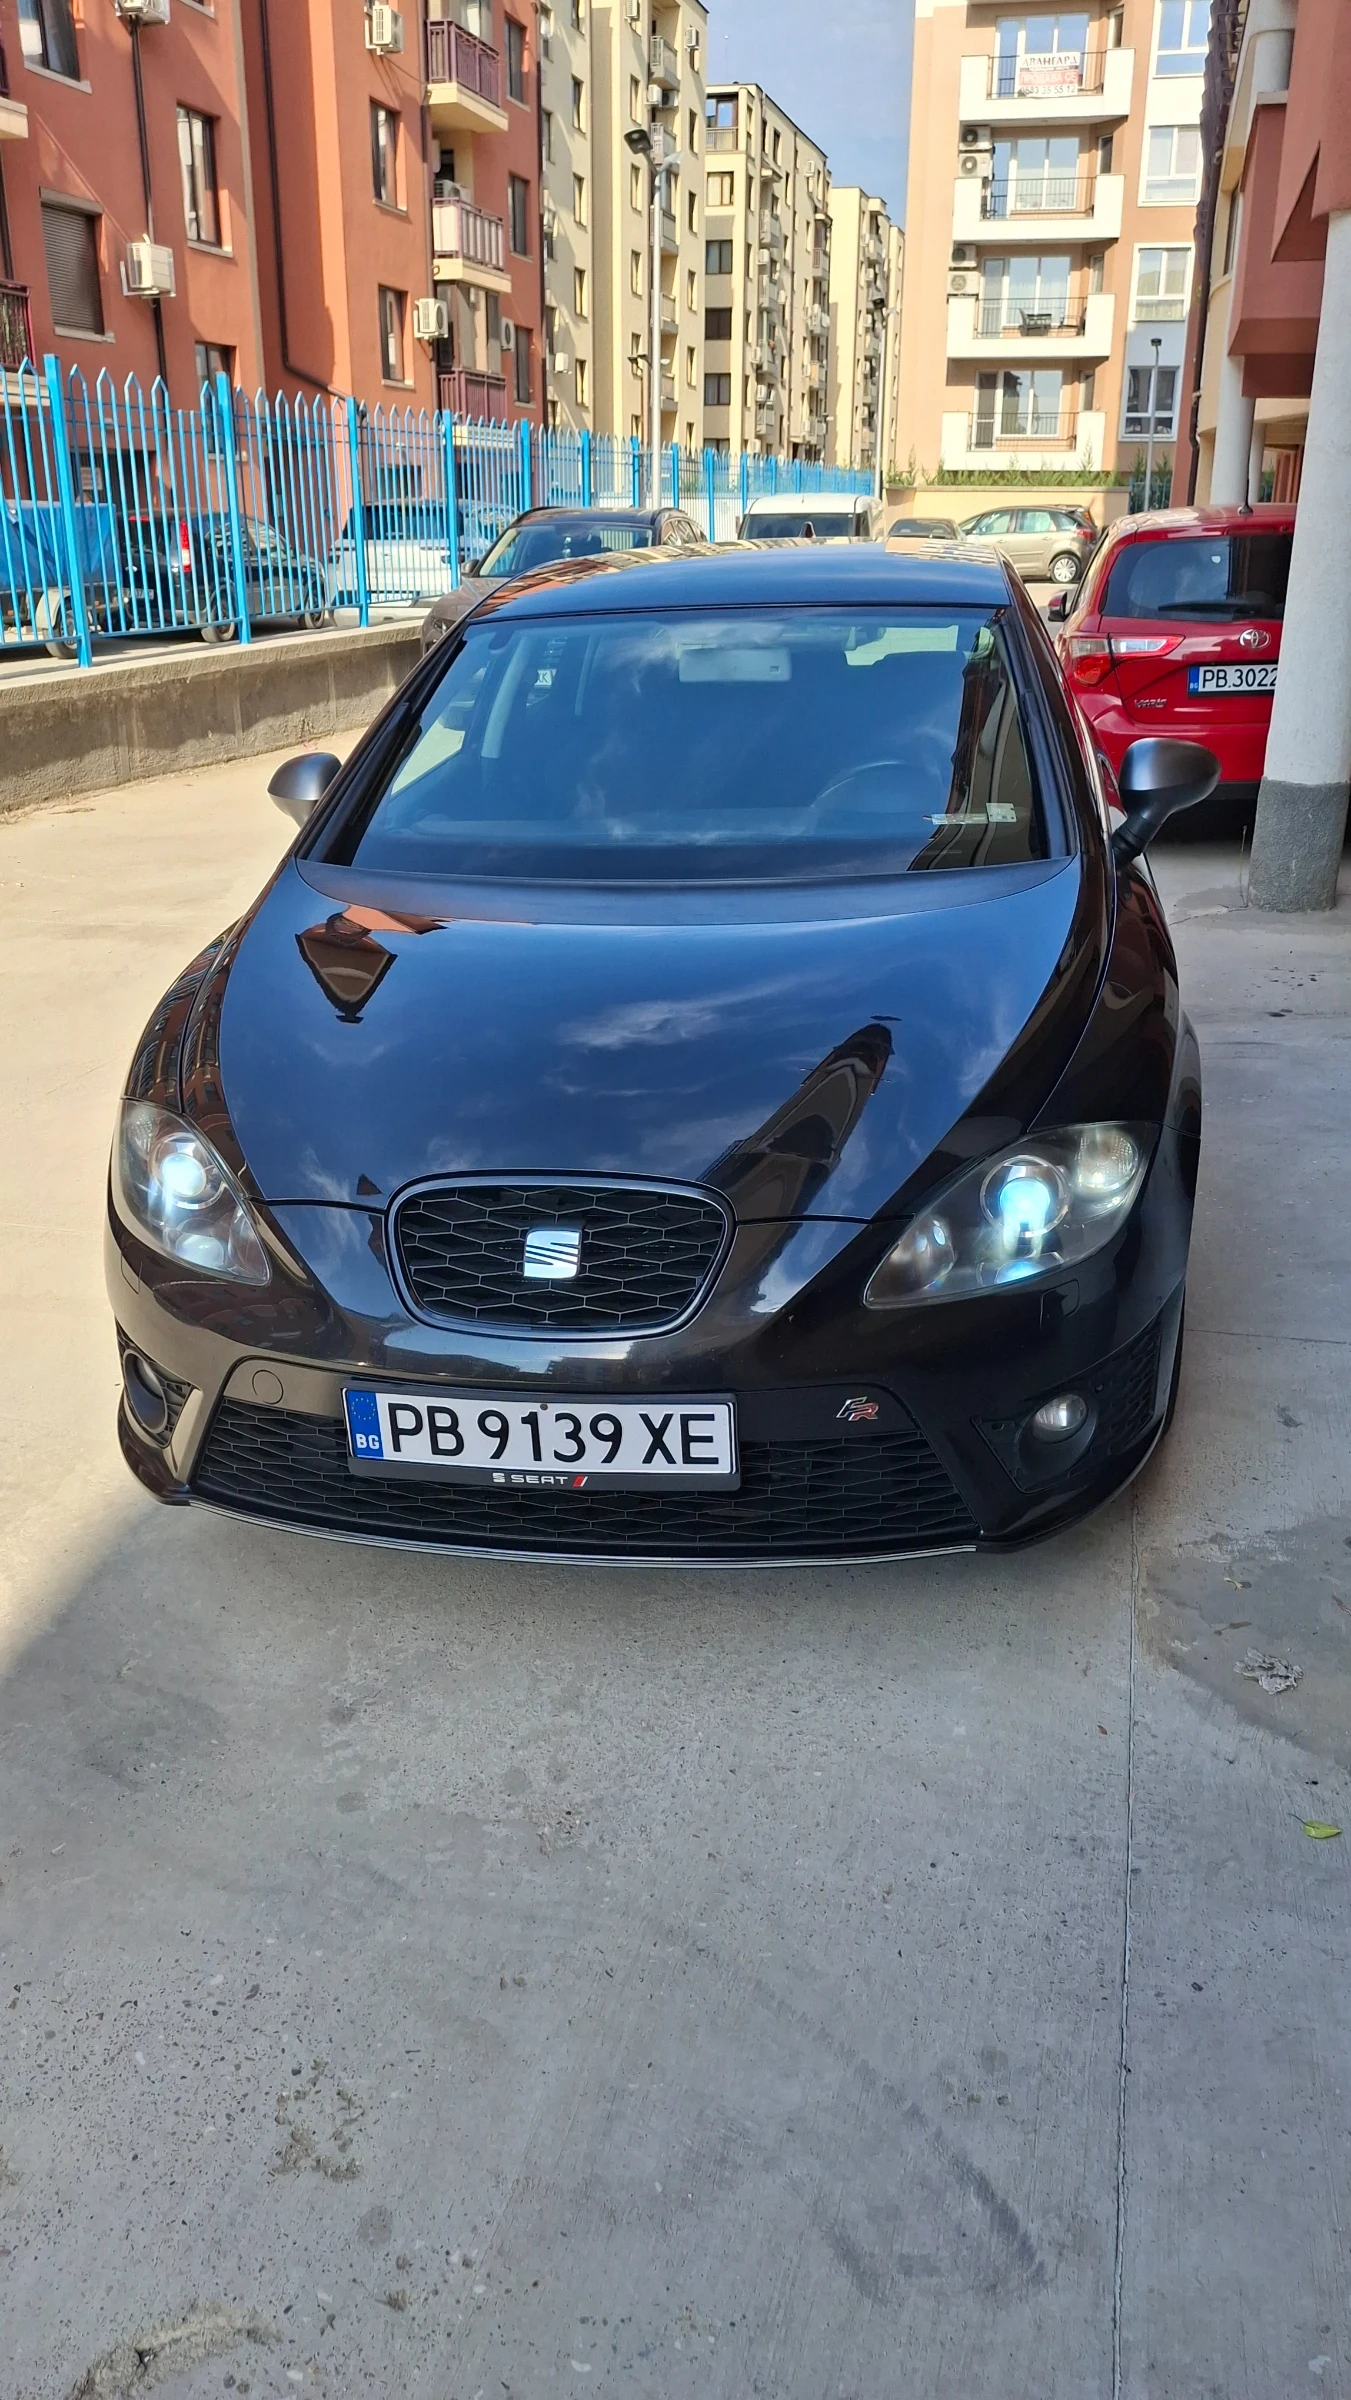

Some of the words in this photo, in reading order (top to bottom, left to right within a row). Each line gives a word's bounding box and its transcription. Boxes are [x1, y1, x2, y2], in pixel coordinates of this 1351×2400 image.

[1022, 56, 1078, 67] АВАНГАРД
[1064, 71, 1078, 83] СЕ
[835, 1396, 879, 1421] FR
[355, 1433, 380, 1450] BG
[387, 1402, 465, 1457] PB
[477, 1409, 624, 1464] 9139
[638, 1413, 720, 1465] XE
[510, 1474, 569, 1485] SEAT
